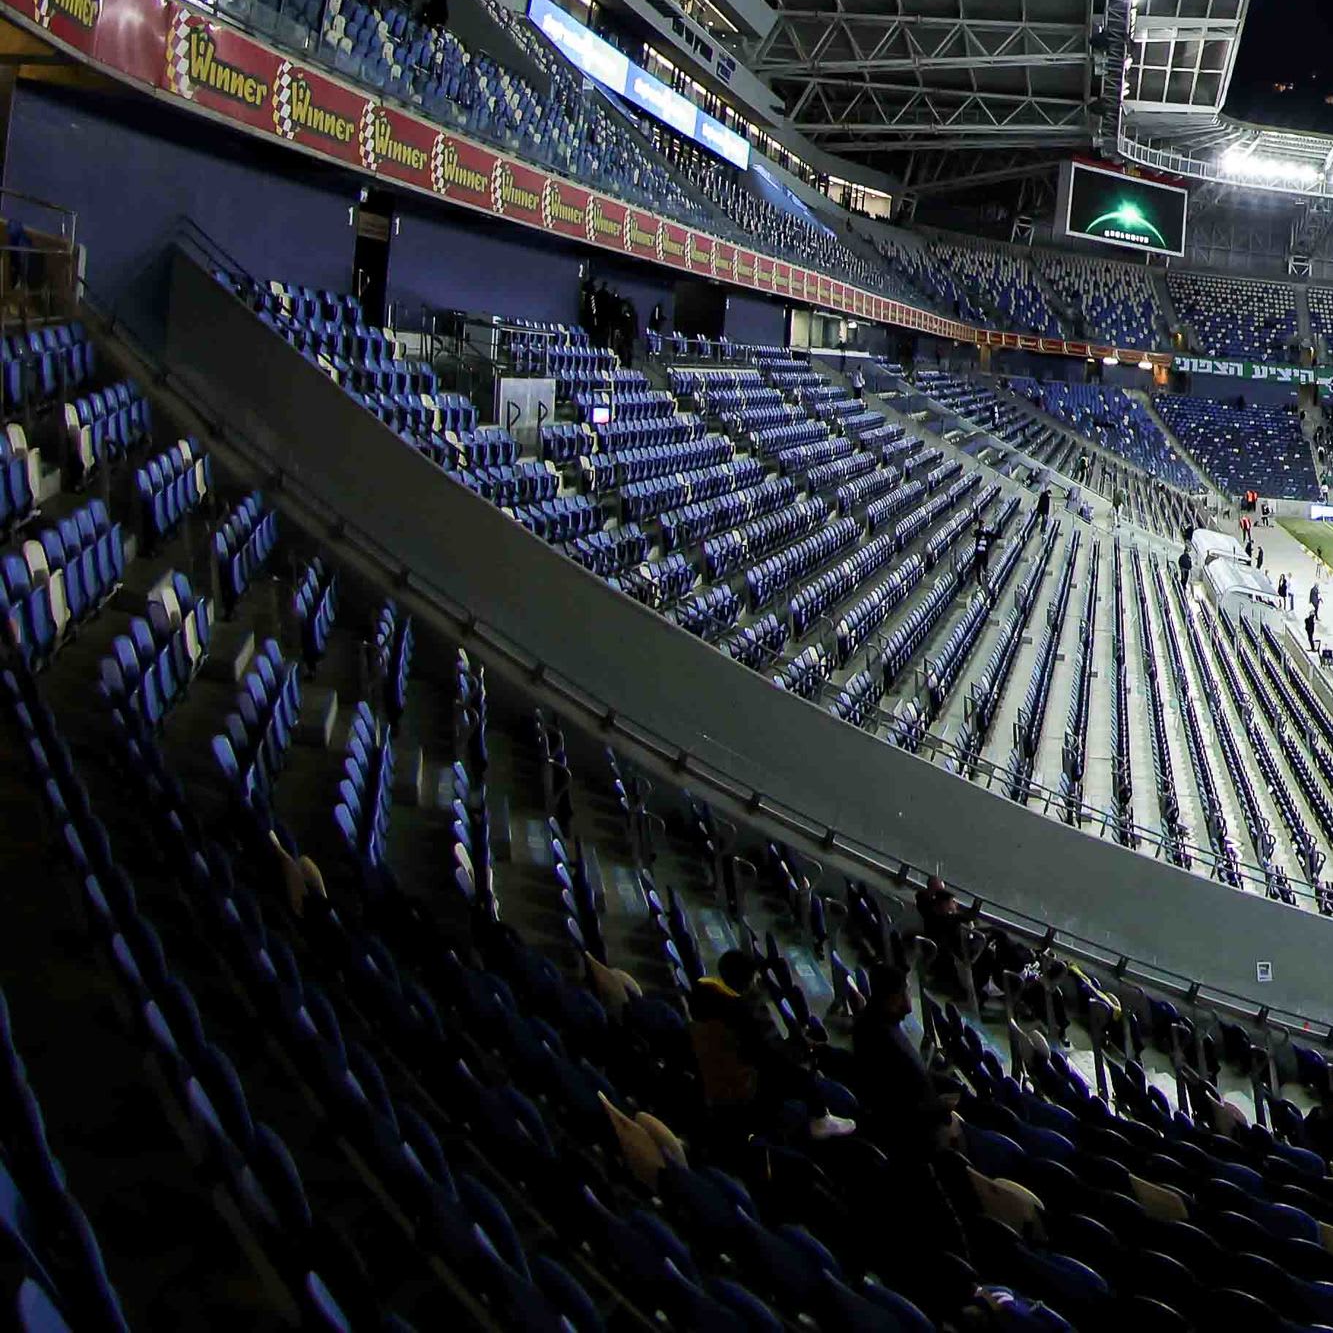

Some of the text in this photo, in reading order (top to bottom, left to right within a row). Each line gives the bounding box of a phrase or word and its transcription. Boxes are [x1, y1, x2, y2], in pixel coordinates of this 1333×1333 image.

[190, 32, 267, 106] Winner
[292, 80, 354, 142] Winner
[374, 118, 427, 170] Winner
[1251, 364, 1315, 384] היציע
